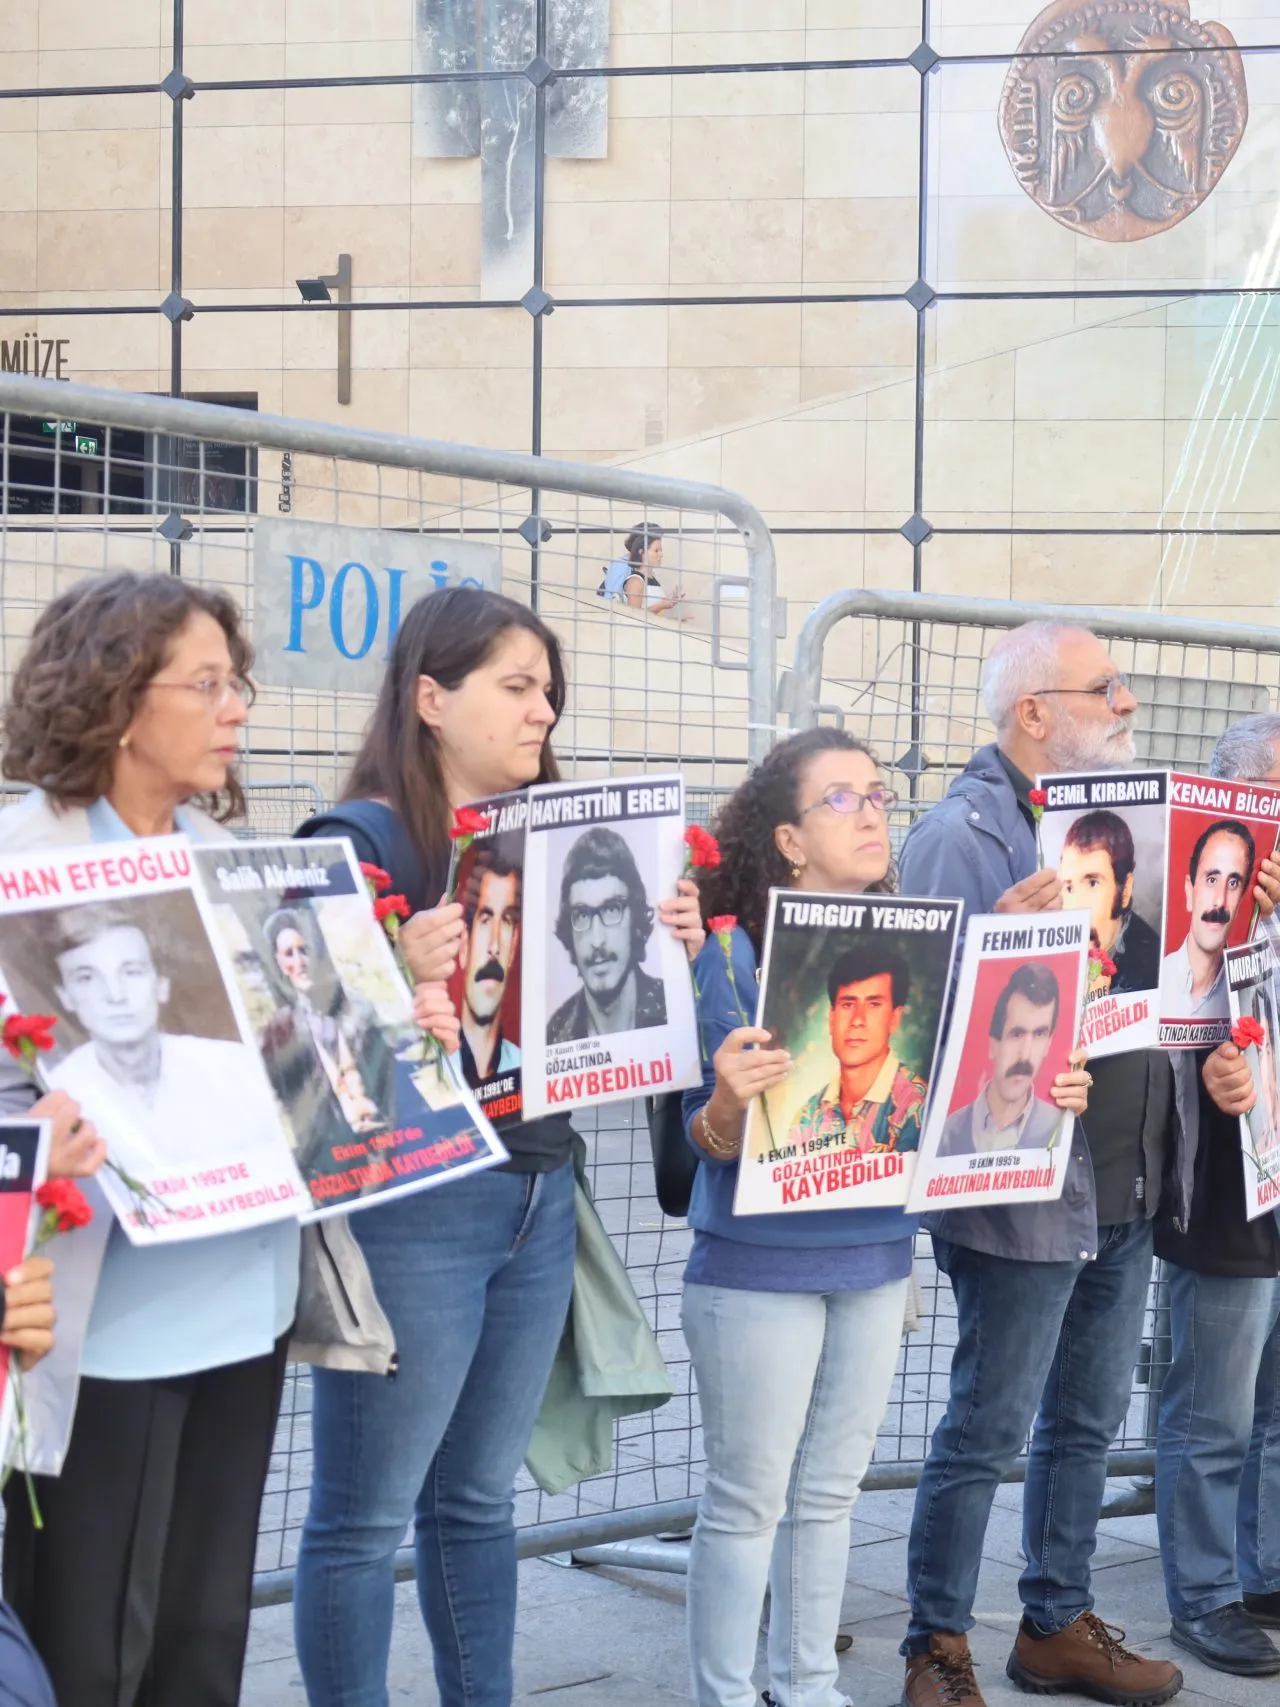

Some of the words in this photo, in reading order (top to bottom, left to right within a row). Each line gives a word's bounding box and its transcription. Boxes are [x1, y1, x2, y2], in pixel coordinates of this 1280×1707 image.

[0, 332, 70, 382] MÜZE
[532, 786, 621, 825] HAYRETTİN
[627, 785, 679, 811] EREN
[1091, 780, 1160, 802] KIRBAYIR
[1170, 781, 1232, 806] KENAN
[0, 867, 62, 902] HAN
[66, 847, 191, 893] EFEOĞLU
[216, 864, 262, 892] Salih
[264, 862, 332, 889] Akdeniz
[781, 901, 865, 928] TURGUT
[981, 926, 1034, 952] FEHMİ
[1038, 924, 1083, 947] TOSUN
[1228, 952, 1260, 984] MURAT
[545, 1050, 612, 1076] GÖZALTINDA
[546, 1052, 673, 1105] KAYBEDİLDİ
[757, 1153, 765, 1164] 4
[772, 1147, 863, 1183] GÖZALTINDA
[926, 1172, 991, 1197] GÖZALTINDA
[992, 1165, 1057, 1190] KAYBEDİLDİ
